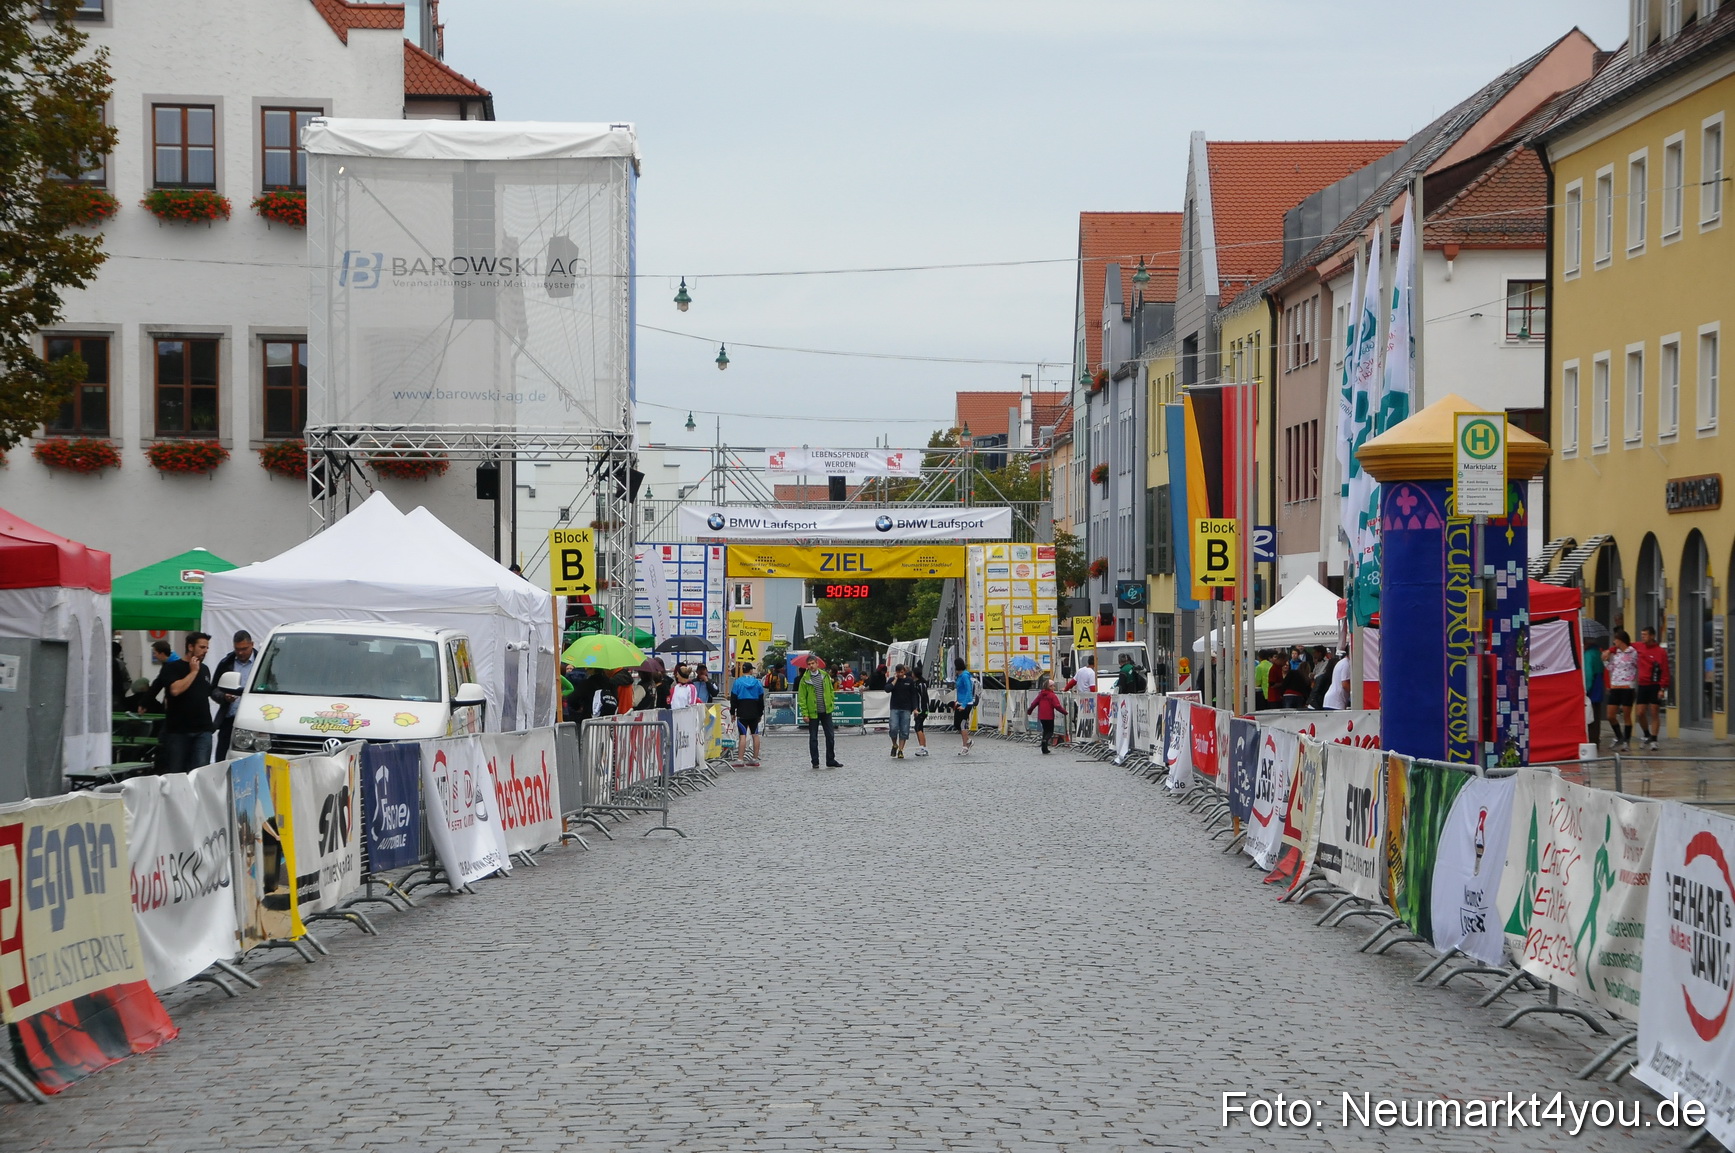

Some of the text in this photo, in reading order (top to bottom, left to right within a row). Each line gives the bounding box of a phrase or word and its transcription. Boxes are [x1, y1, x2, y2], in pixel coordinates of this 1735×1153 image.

[392, 256, 588, 278] BAROWSKI AG
[393, 278, 587, 290] Veranstaltungs- und Mediensysteme
[392, 387, 546, 404] www.barowski-ag.de
[1471, 428, 1490, 451] H
[811, 450, 869, 459] LEBENSSPENDER
[824, 460, 856, 468] WERDEN!
[1463, 463, 1497, 471] Marktplatz
[729, 518, 817, 531] BMW Laufsport
[897, 518, 984, 530] BMW Laufsport
[1200, 521, 1235, 534] Block
[554, 531, 589, 544] Block
[820, 553, 873, 572] ZIEL
[1206, 539, 1230, 571] B
[561, 549, 585, 581] B
[826, 584, 869, 598] 9:09:38
[1075, 617, 1094, 625] Block
[1078, 626, 1092, 643] A
[740, 639, 754, 655] A
[1446, 685, 1472, 765] 28.09.2
[130, 857, 168, 914] Audi
